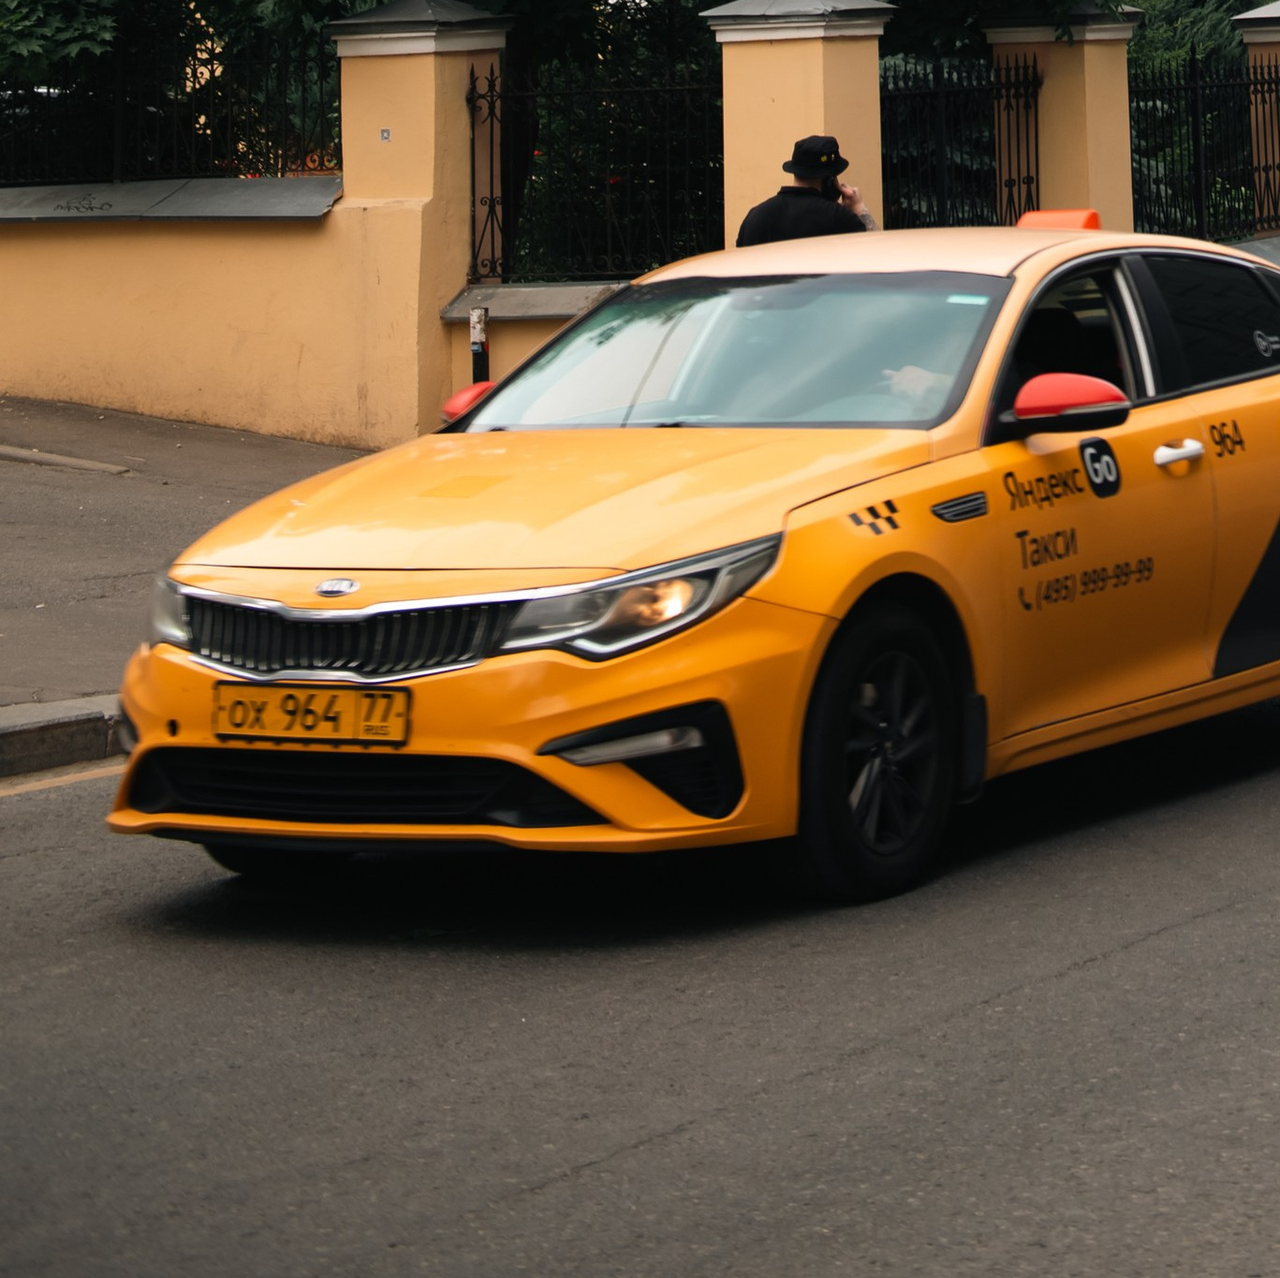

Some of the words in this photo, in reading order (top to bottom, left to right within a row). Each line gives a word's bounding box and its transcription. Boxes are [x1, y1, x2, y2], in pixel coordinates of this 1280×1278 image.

[1209, 419, 1245, 458] 964
[1003, 468, 1084, 511] Яндекс
[1083, 447, 1117, 484] Go
[1015, 528, 1078, 570] Такси
[1035, 574, 1077, 611] (495)
[1080, 557, 1154, 596] 999-99-99
[280, 693, 342, 733] 964
[361, 693, 395, 723] 77
